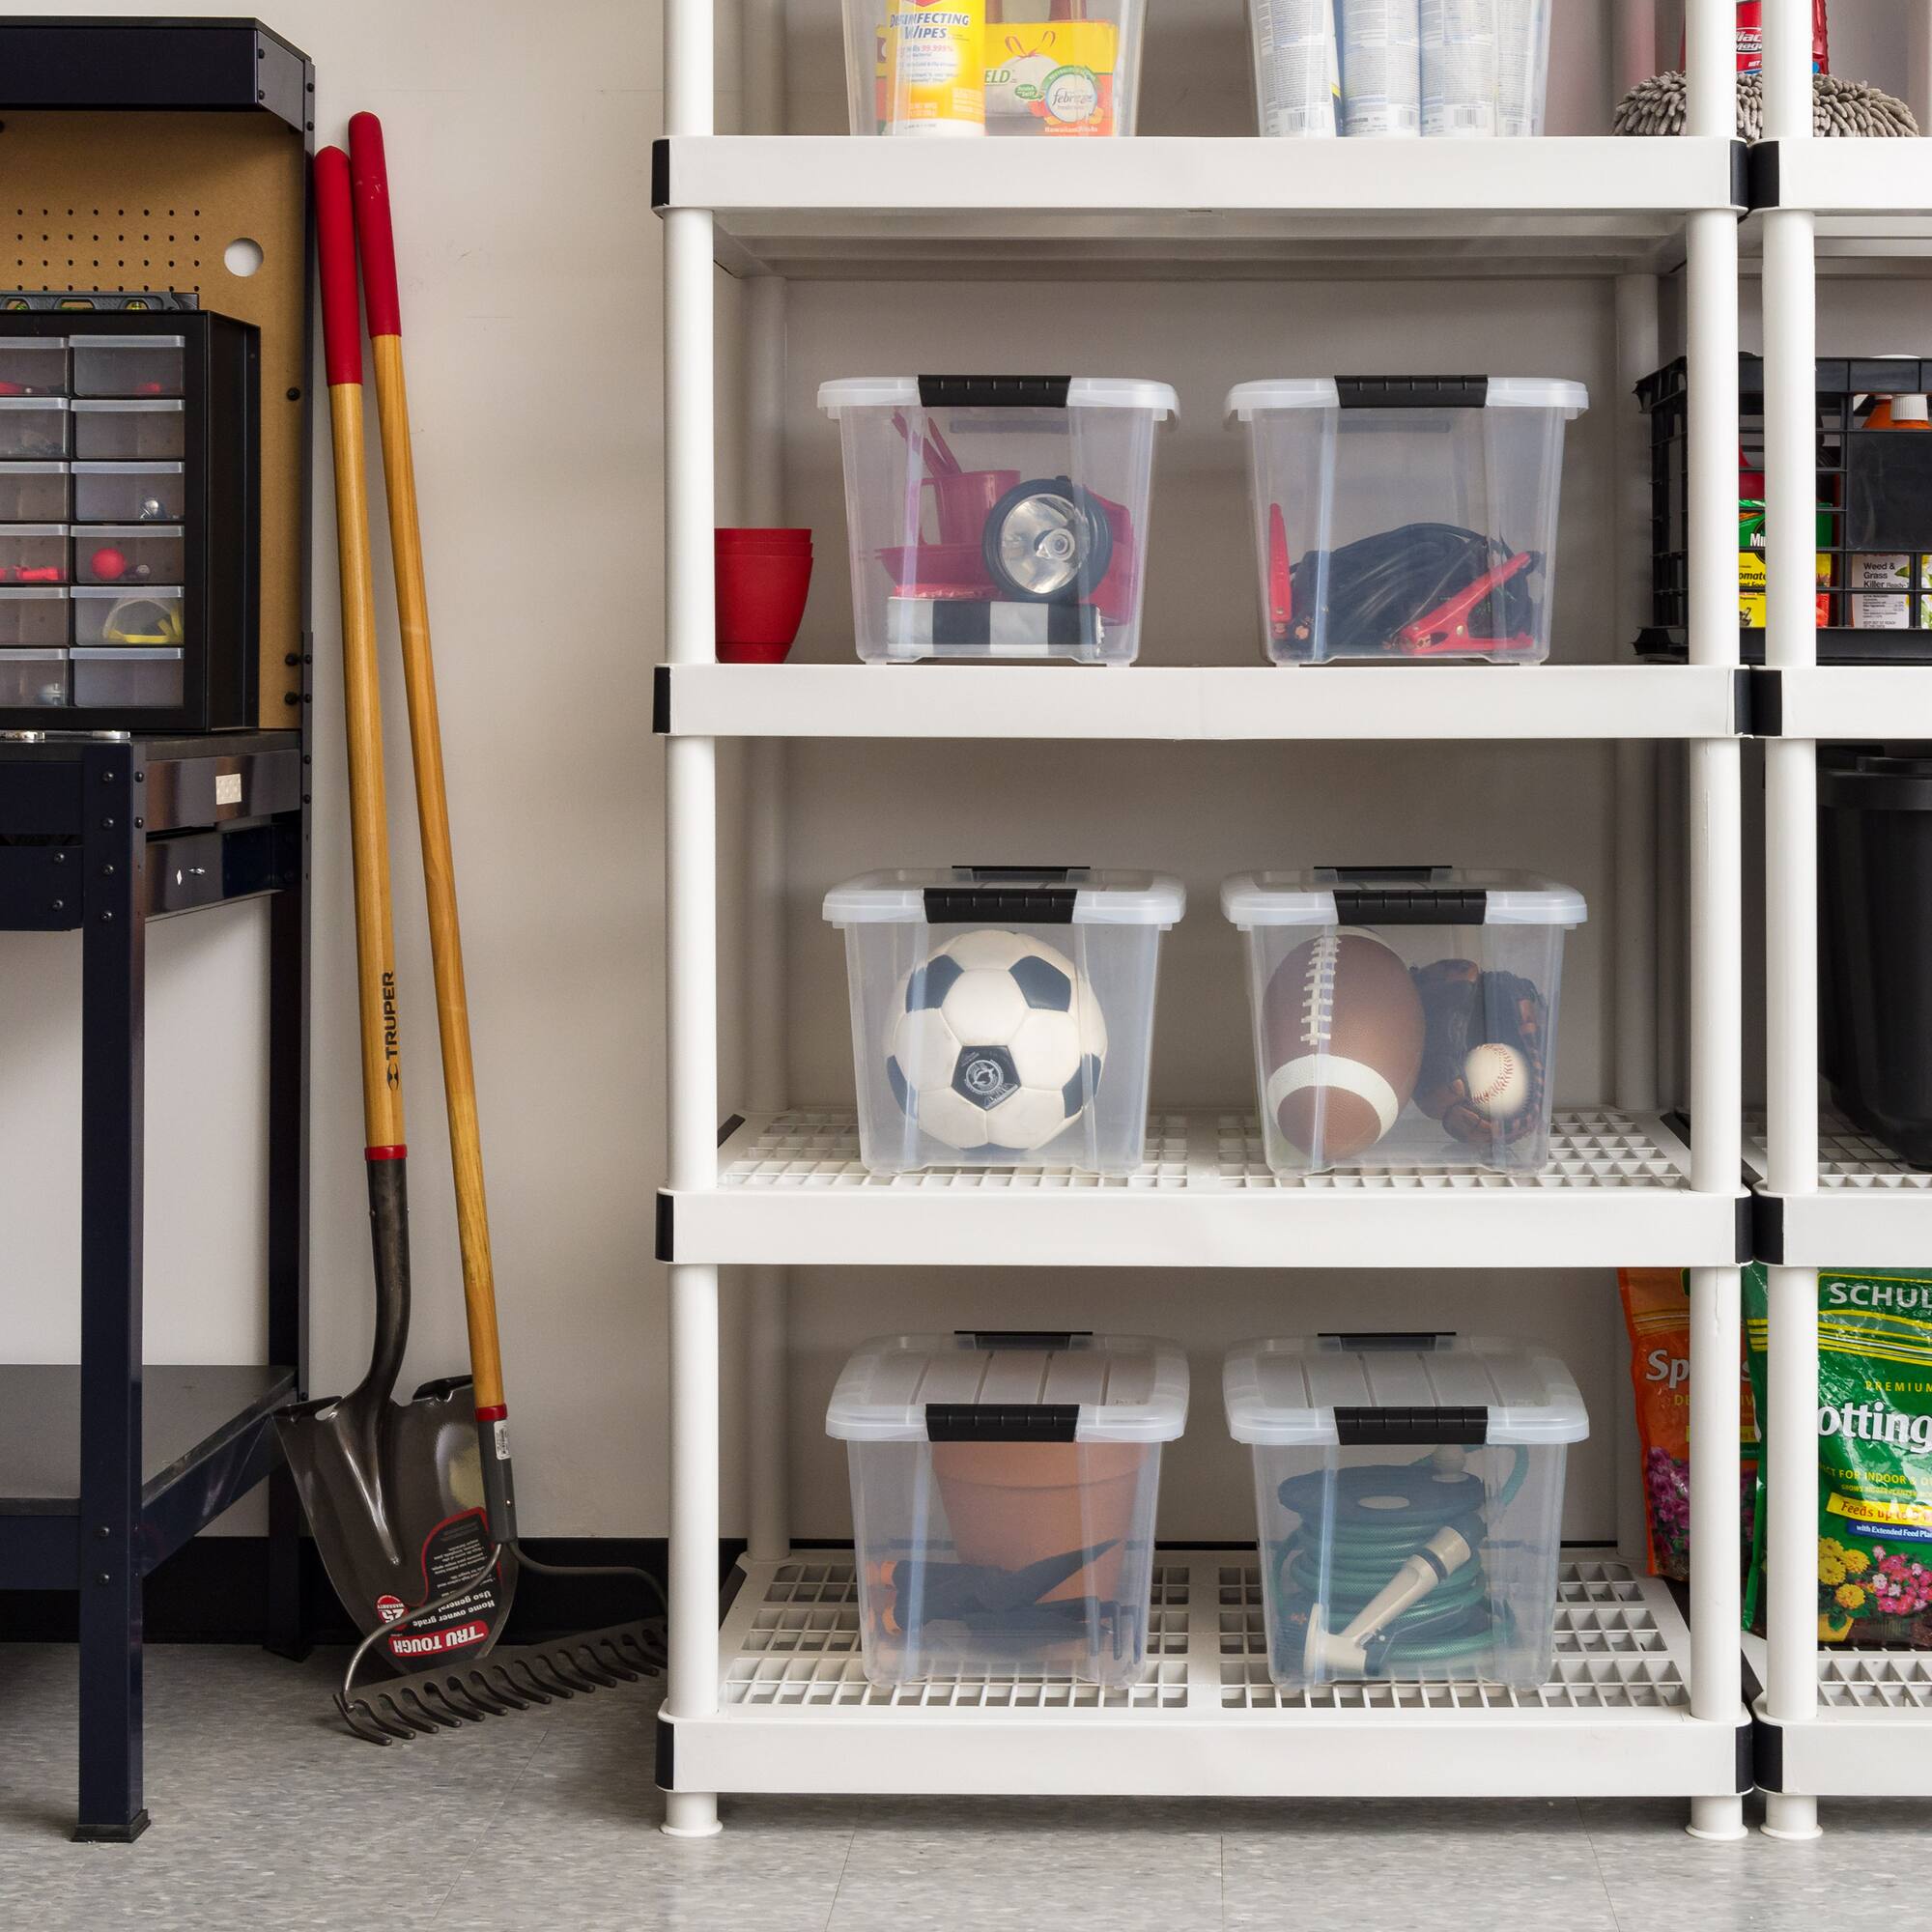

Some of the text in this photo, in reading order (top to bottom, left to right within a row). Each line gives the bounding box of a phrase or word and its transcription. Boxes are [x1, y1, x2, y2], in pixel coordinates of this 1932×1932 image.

[904, 25, 948, 40] WIPES
[1737, 31, 1762, 43] lac
[984, 70, 1010, 83] ELD
[382, 971, 399, 1061] TRUPER
[1829, 1282, 1932, 1309] SCHUL
[1865, 1379, 1932, 1393] PREMIUM
[1817, 1401, 1932, 1454] otting
[1838, 1469, 1861, 1480] FOR
[1864, 1471, 1907, 1485] INDOOR
[1840, 1500, 1874, 1518] Feeds
[1877, 1509, 1892, 1520] up
[1856, 1524, 1871, 1533] with
[1871, 1525, 1902, 1537] Extended
[1903, 1527, 1919, 1538] Feed
[473, 1590, 492, 1601] Uso
[412, 1600, 495, 1628] Home owner grade
[392, 1626, 484, 1654] TRU TOUGH
